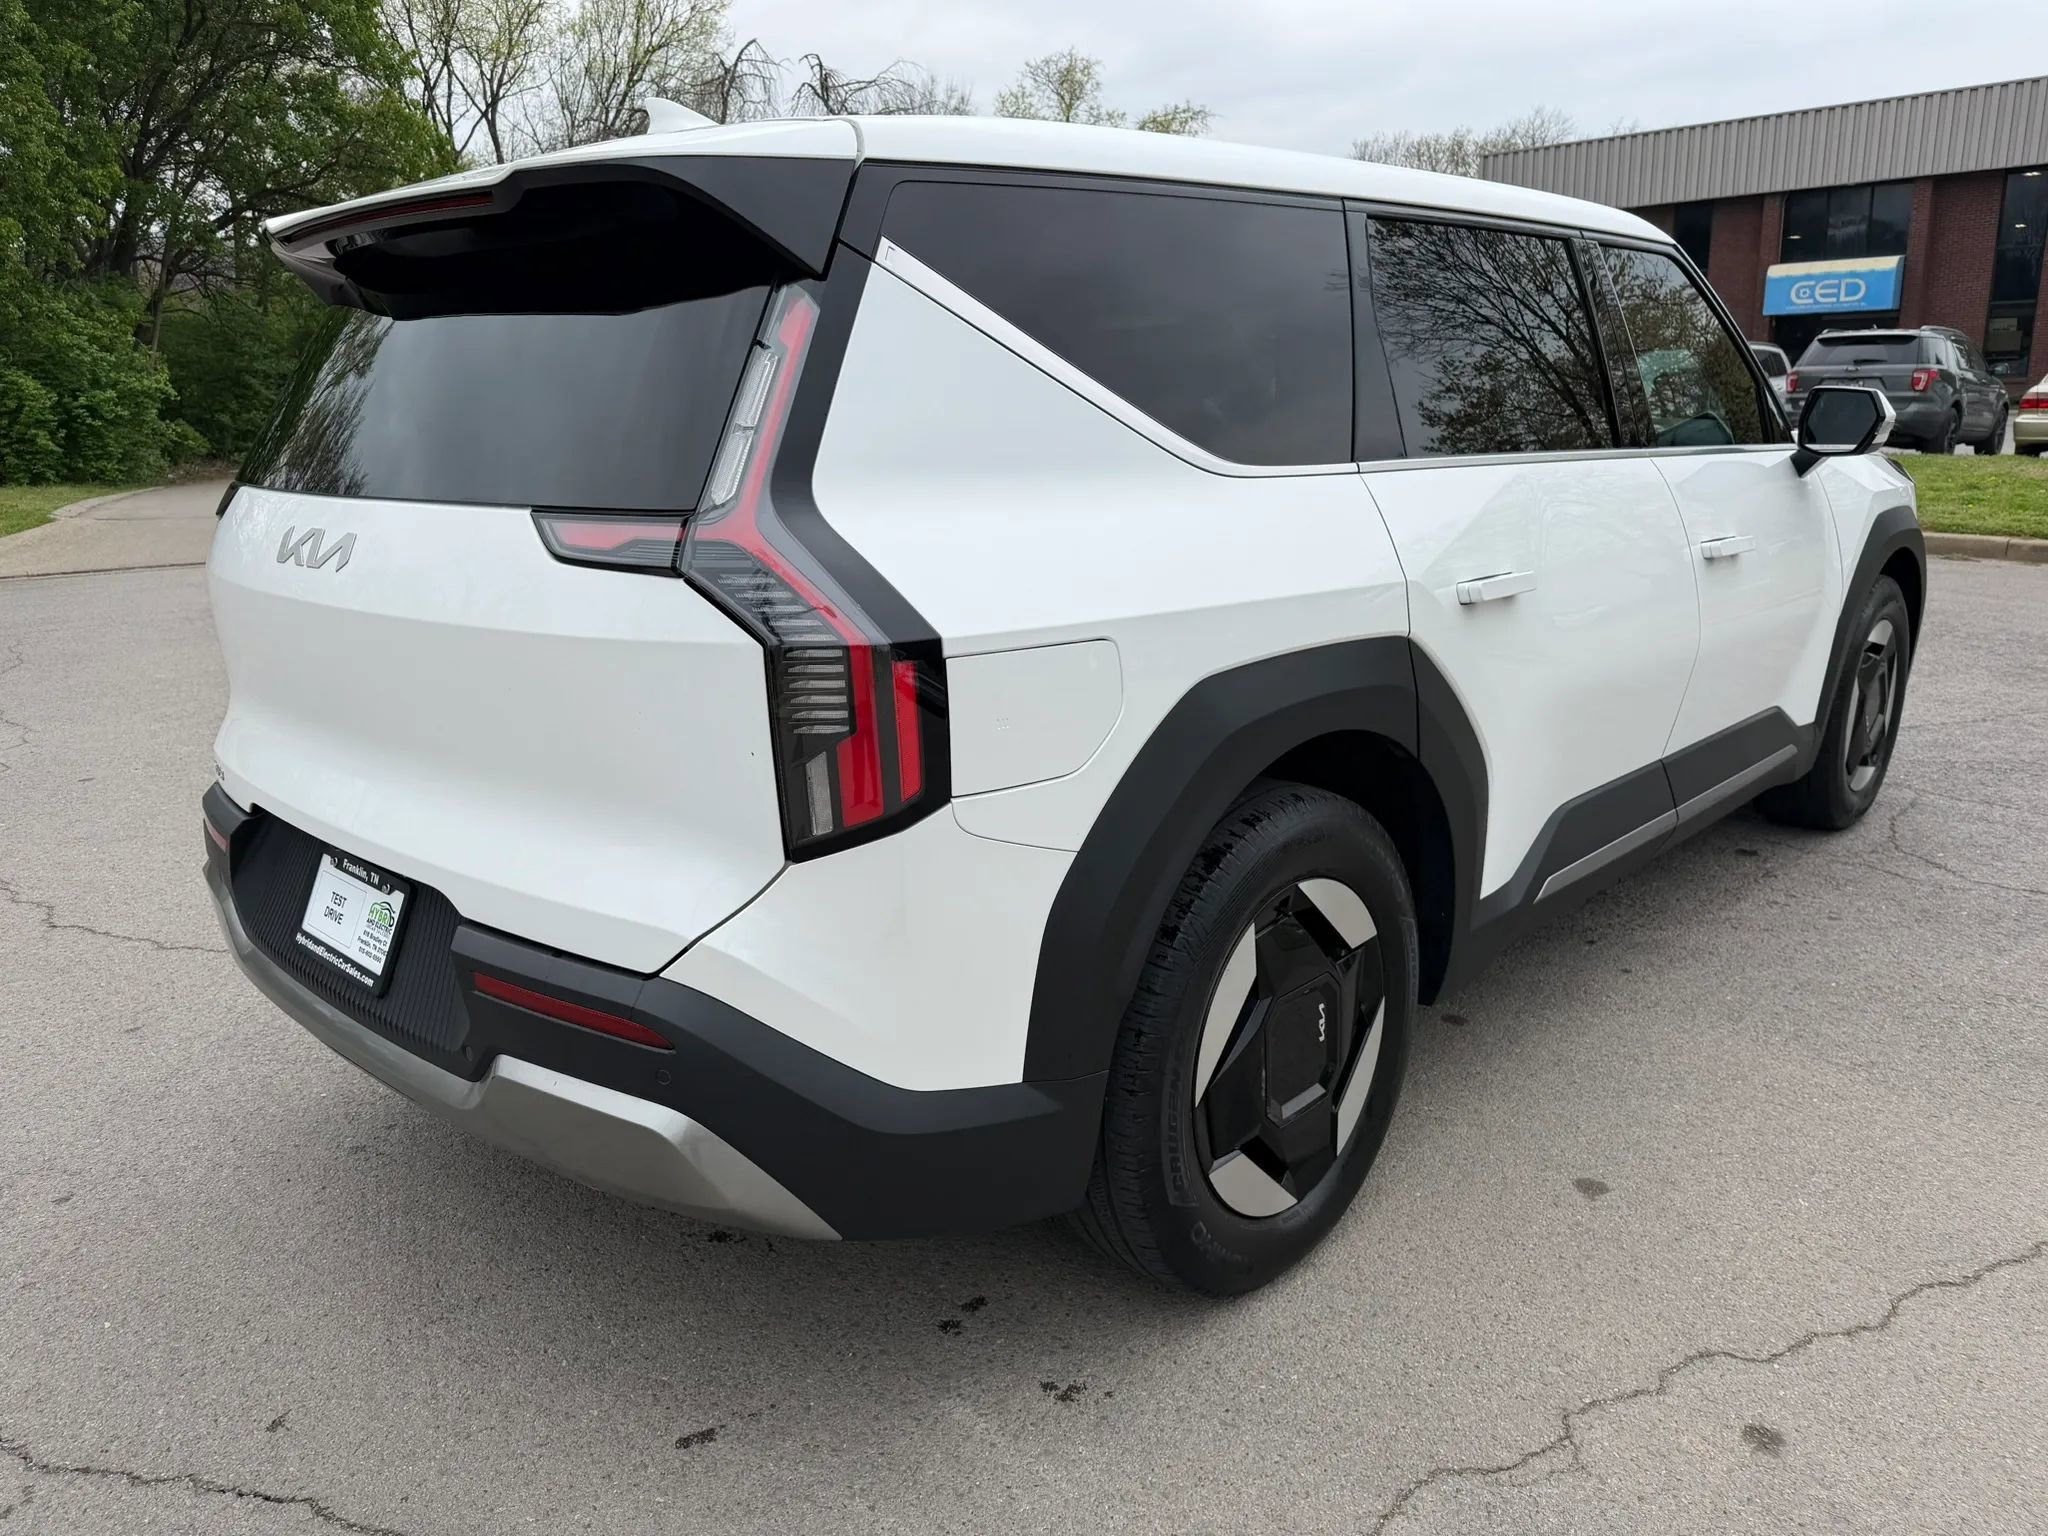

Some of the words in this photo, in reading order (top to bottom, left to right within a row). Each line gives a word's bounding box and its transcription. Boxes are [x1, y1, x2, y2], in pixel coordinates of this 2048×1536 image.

[1790, 278, 1867, 305] CED
[276, 525, 357, 573] KIA
[343, 858, 369, 882] Franklin,
[371, 871, 379, 886] TN
[331, 892, 347, 908] TEST
[324, 906, 344, 925] DRIVE
[295, 931, 375, 988] HybridandElectricCarSales.com
